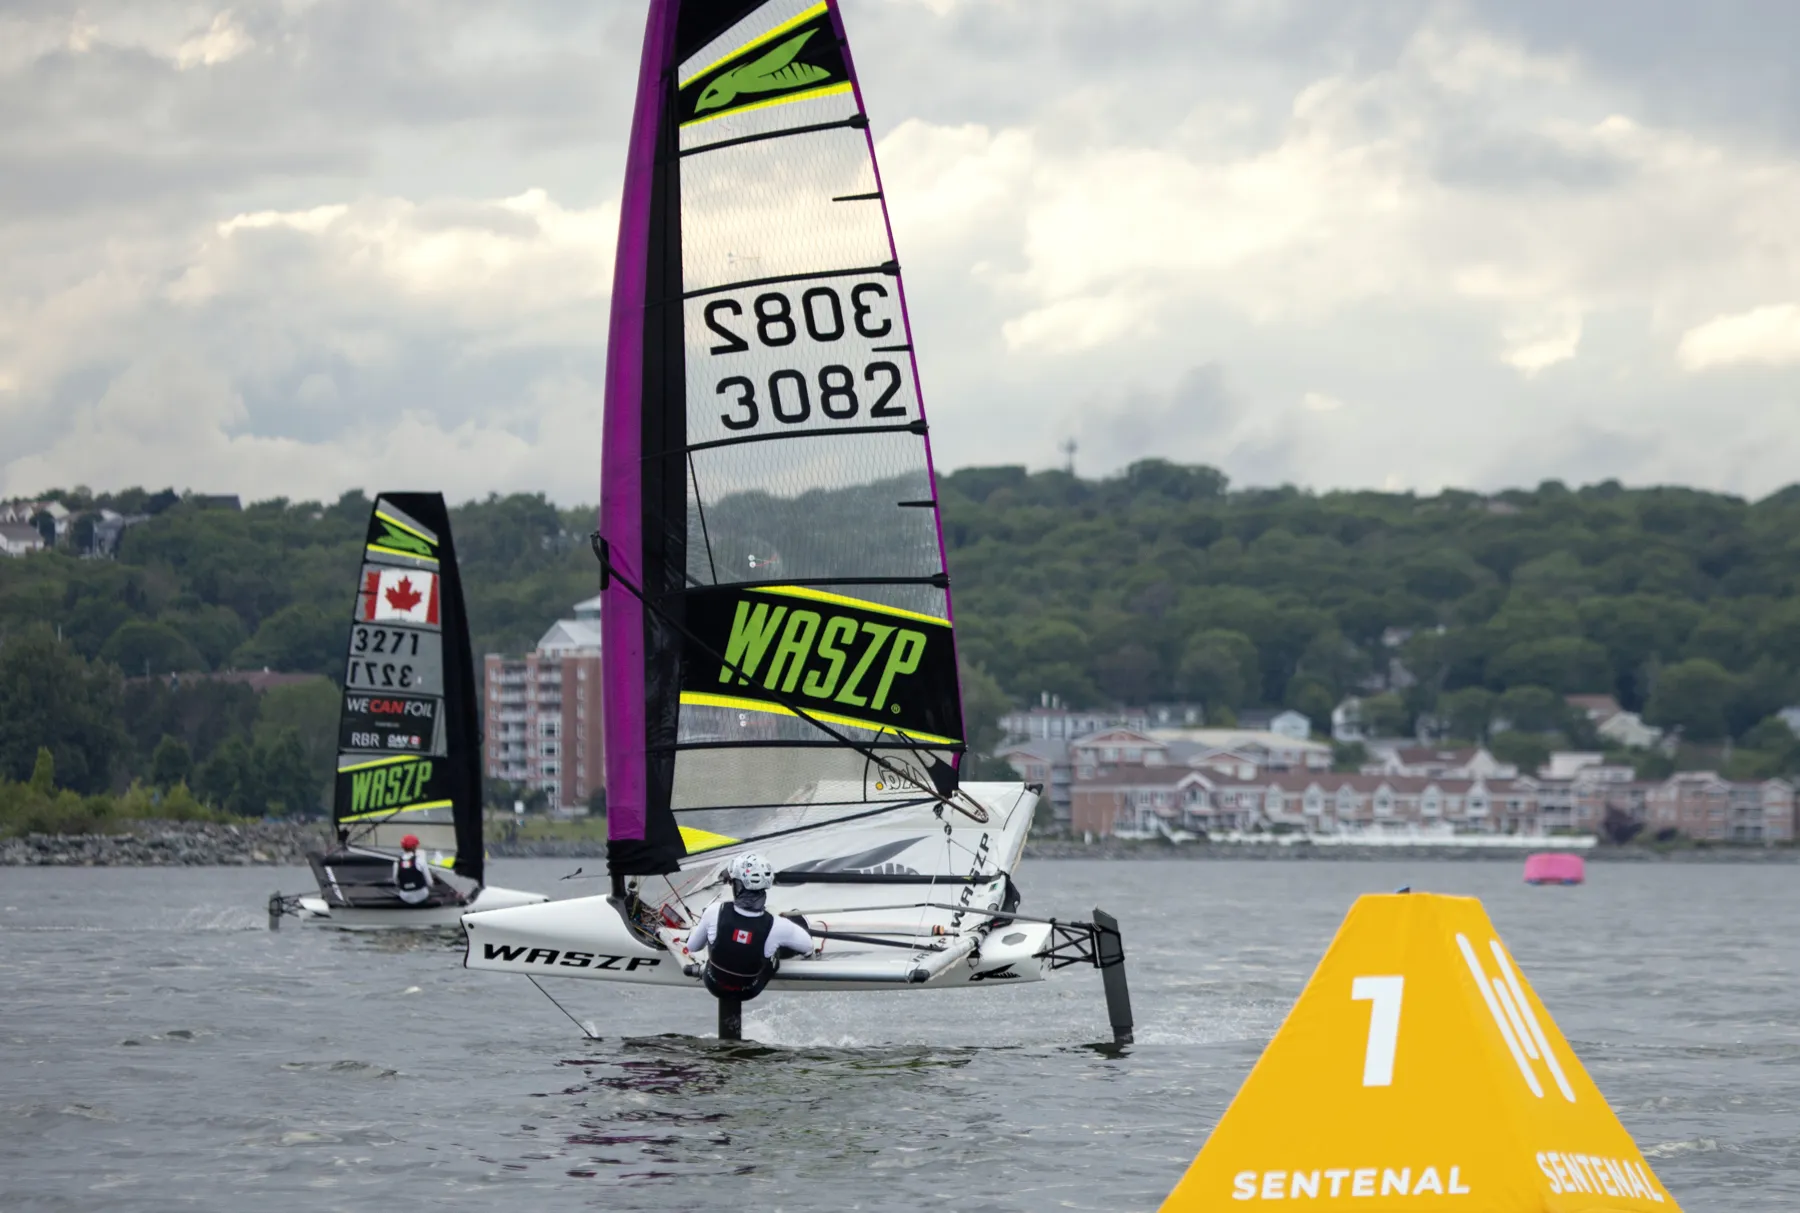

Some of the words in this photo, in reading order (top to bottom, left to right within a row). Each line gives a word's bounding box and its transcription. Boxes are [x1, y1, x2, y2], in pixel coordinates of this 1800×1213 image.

[716, 361, 907, 430] 3082
[355, 628, 419, 656] 3271
[718, 600, 927, 711] WASZP
[347, 697, 369, 713] WE
[369, 699, 404, 713] CAN
[404, 701, 432, 718] FOIL
[351, 731, 380, 748] RBR
[351, 760, 433, 813] WASZP
[484, 943, 661, 972] WASZP
[1351, 975, 1404, 1087] 1
[1231, 1165, 1471, 1201] SENTENAL
[1535, 1151, 1664, 1203] SENTENAL
